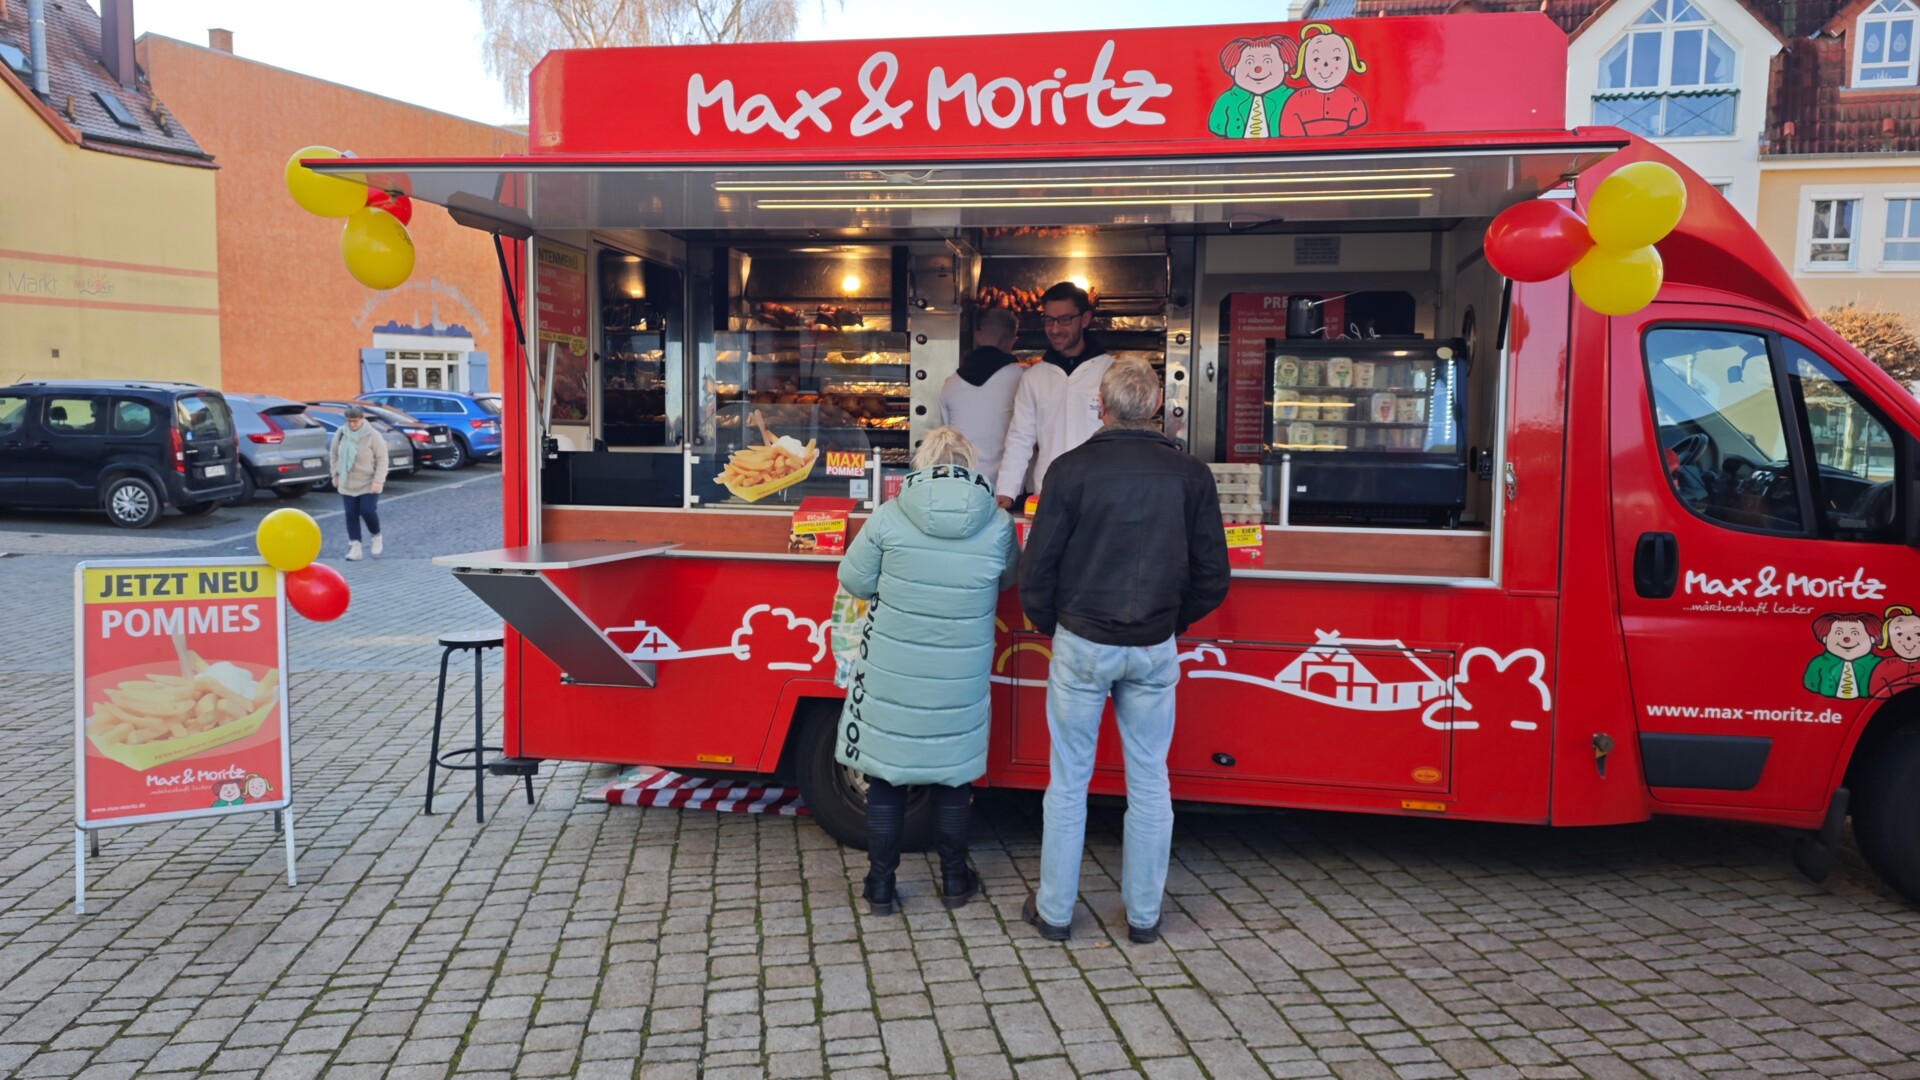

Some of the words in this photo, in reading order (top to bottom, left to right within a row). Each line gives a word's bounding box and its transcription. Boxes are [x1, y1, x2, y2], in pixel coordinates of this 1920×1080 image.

[687, 73, 842, 139] Max
[849, 51, 914, 136] &
[926, 39, 1173, 131] Moritz
[8, 271, 58, 297] Markt
[826, 451, 866, 468] MAXI
[826, 466, 865, 477] POMMES
[100, 572, 189, 598] JETZT
[198, 570, 258, 594] NEU
[1684, 569, 1752, 597] Max
[1754, 565, 1782, 598] &
[1787, 566, 1886, 600] Moritz
[1773, 600, 1815, 615] lecker
[101, 604, 261, 639] POMMES
[1646, 703, 1843, 724] www.max-moritz.de
[146, 773, 180, 787] Max
[182, 768, 196, 784] &
[197, 763, 246, 782] Moritz
